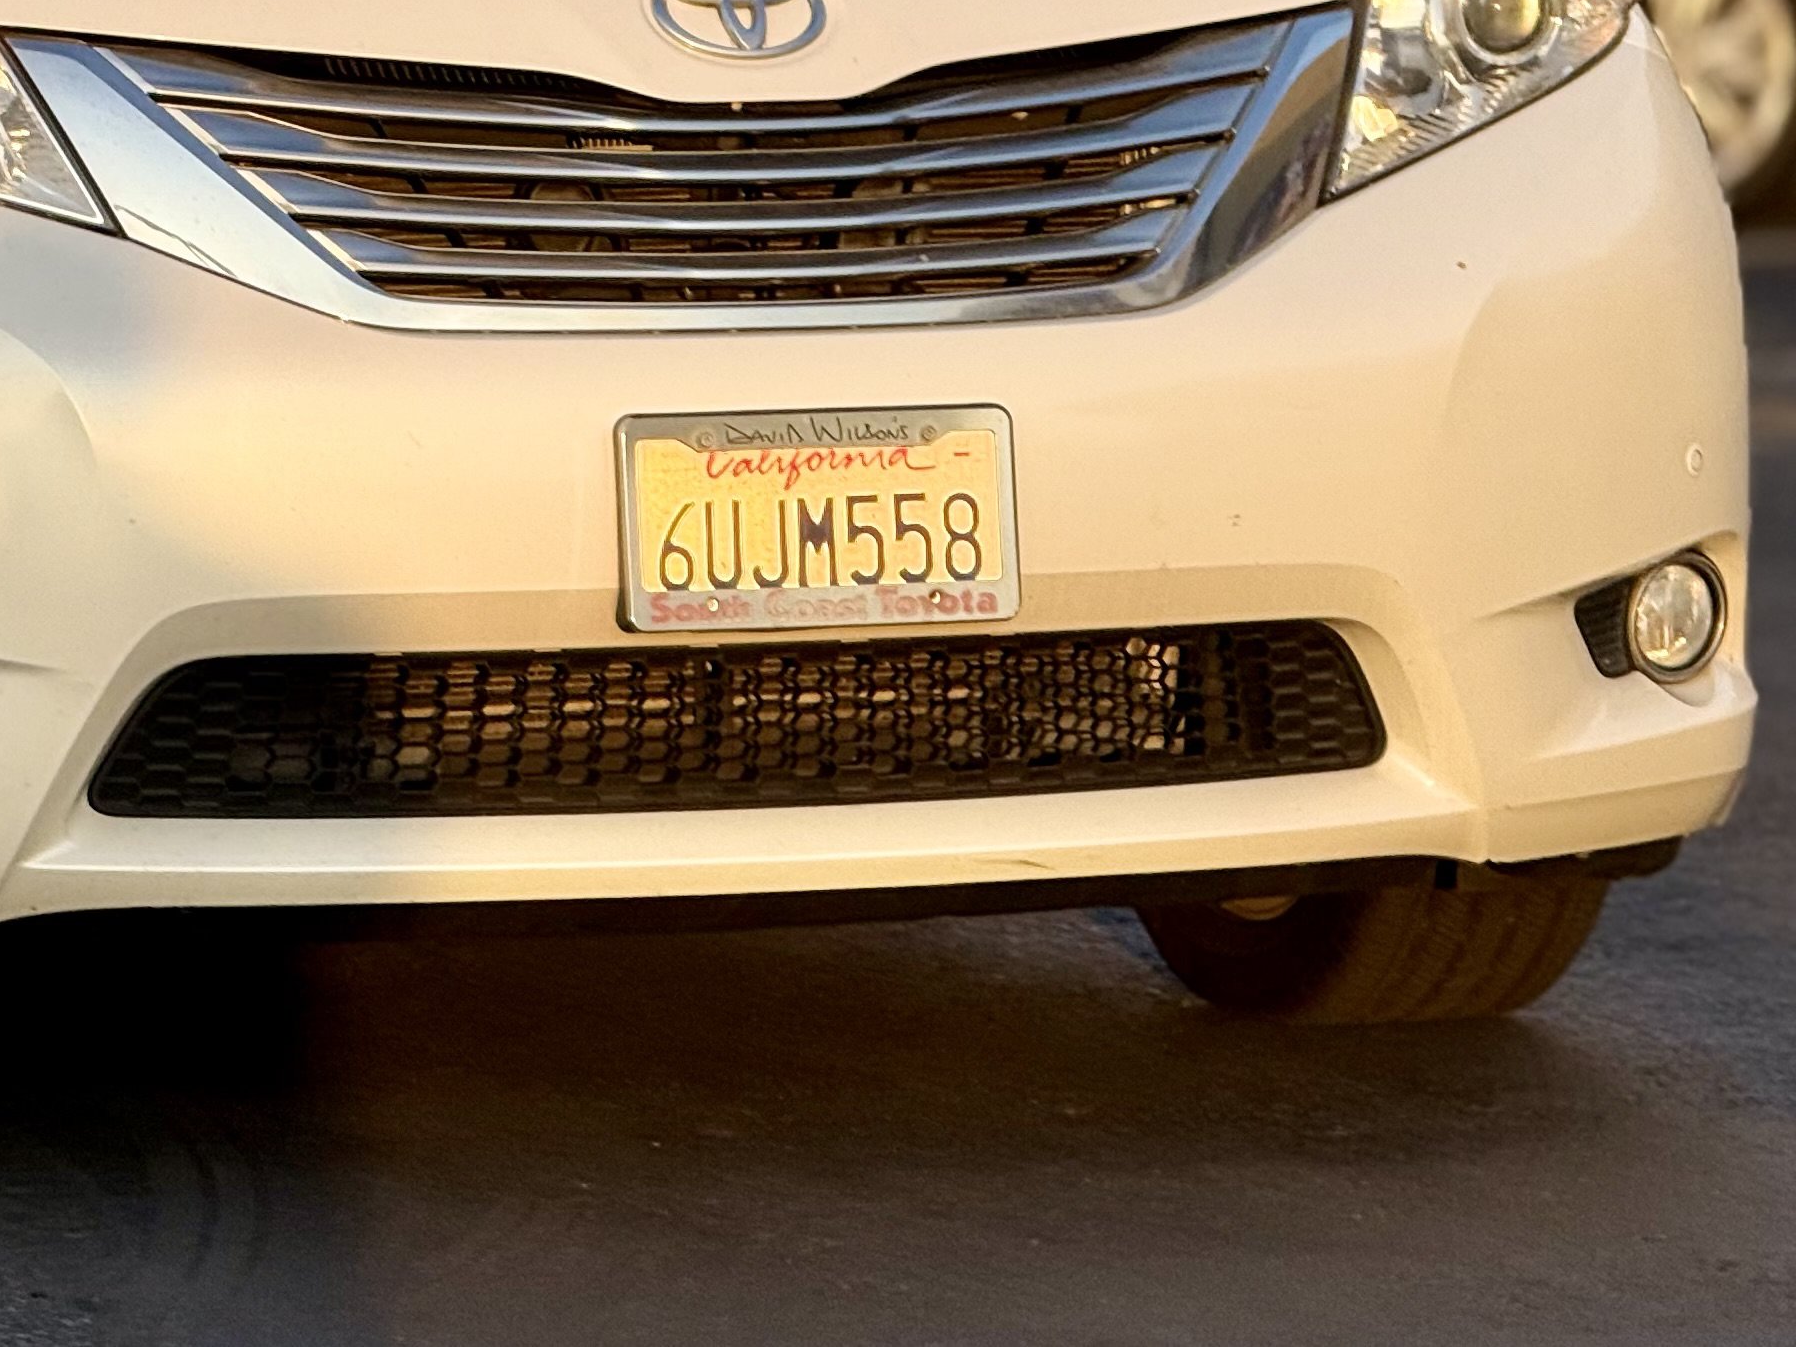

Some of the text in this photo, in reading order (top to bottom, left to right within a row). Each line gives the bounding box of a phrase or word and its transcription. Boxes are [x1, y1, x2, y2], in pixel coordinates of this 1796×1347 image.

[706, 446, 937, 491] California
[659, 492, 983, 592] 6UJM558
[875, 584, 999, 621] Toyota
